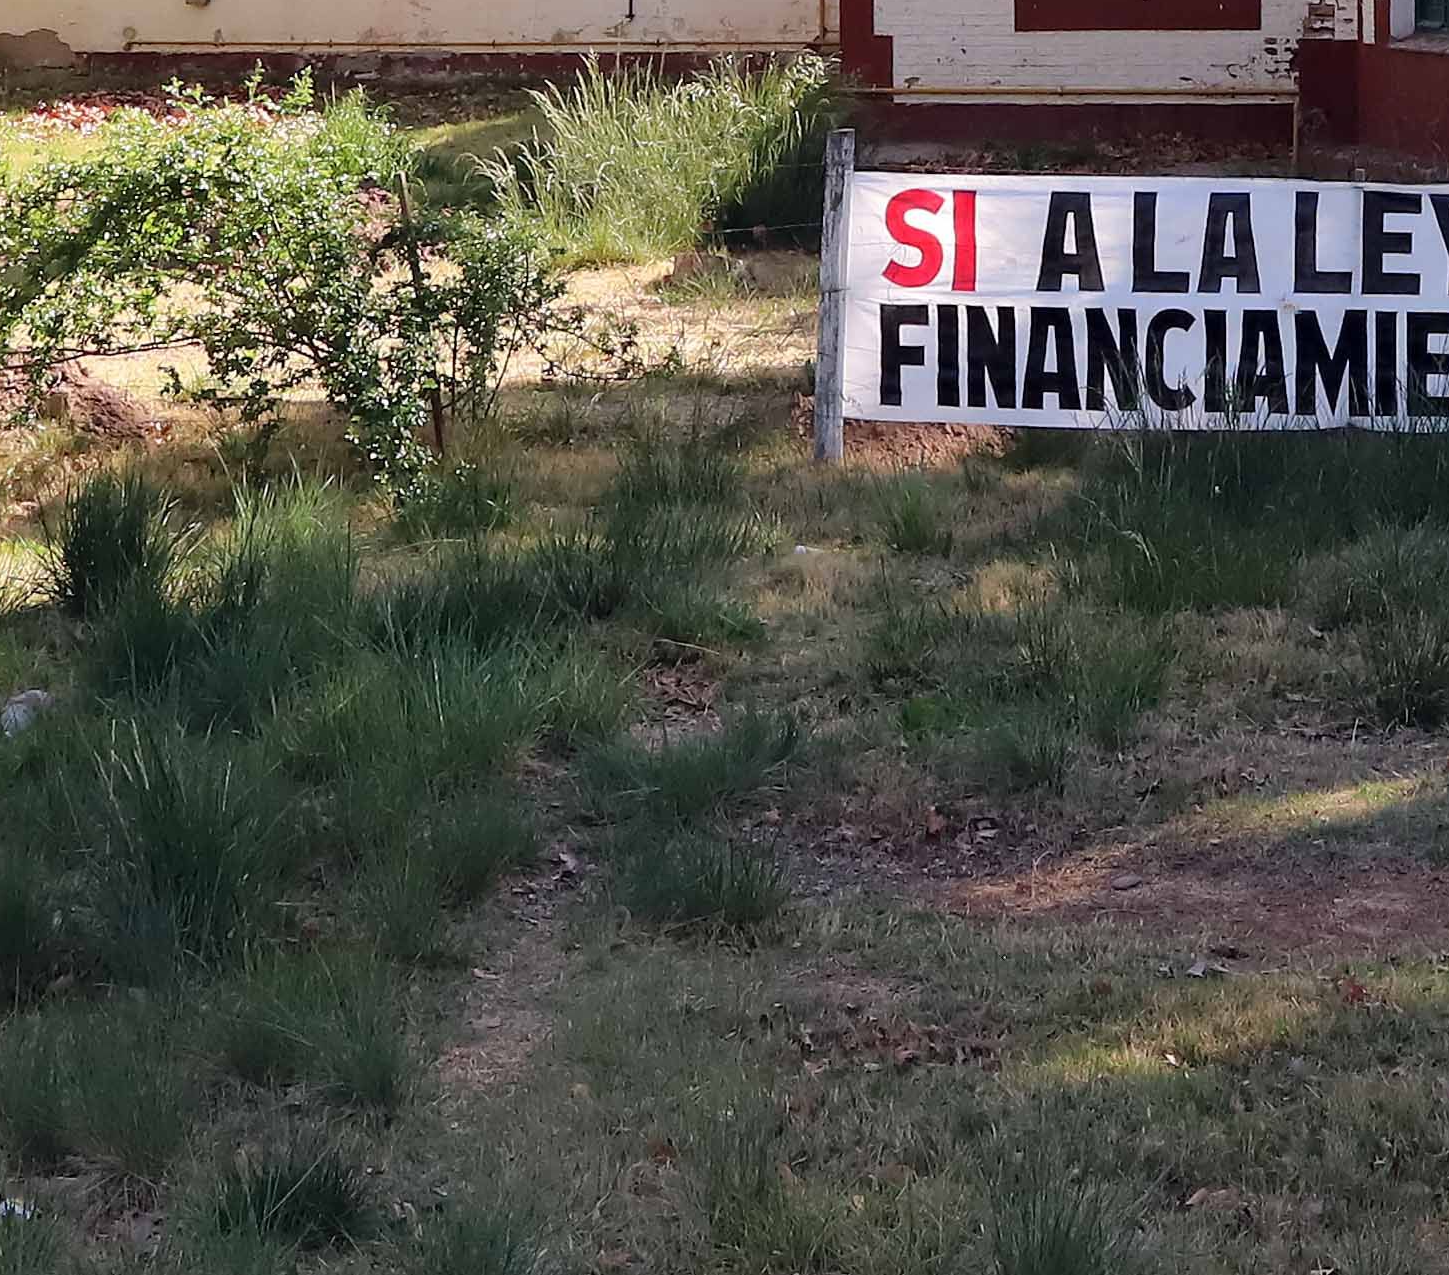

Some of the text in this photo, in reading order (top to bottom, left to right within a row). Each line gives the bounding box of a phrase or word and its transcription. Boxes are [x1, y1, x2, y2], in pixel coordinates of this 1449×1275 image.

[882, 188, 976, 292] SI
[1036, 191, 1105, 293] A
[1131, 191, 1261, 294] LA
